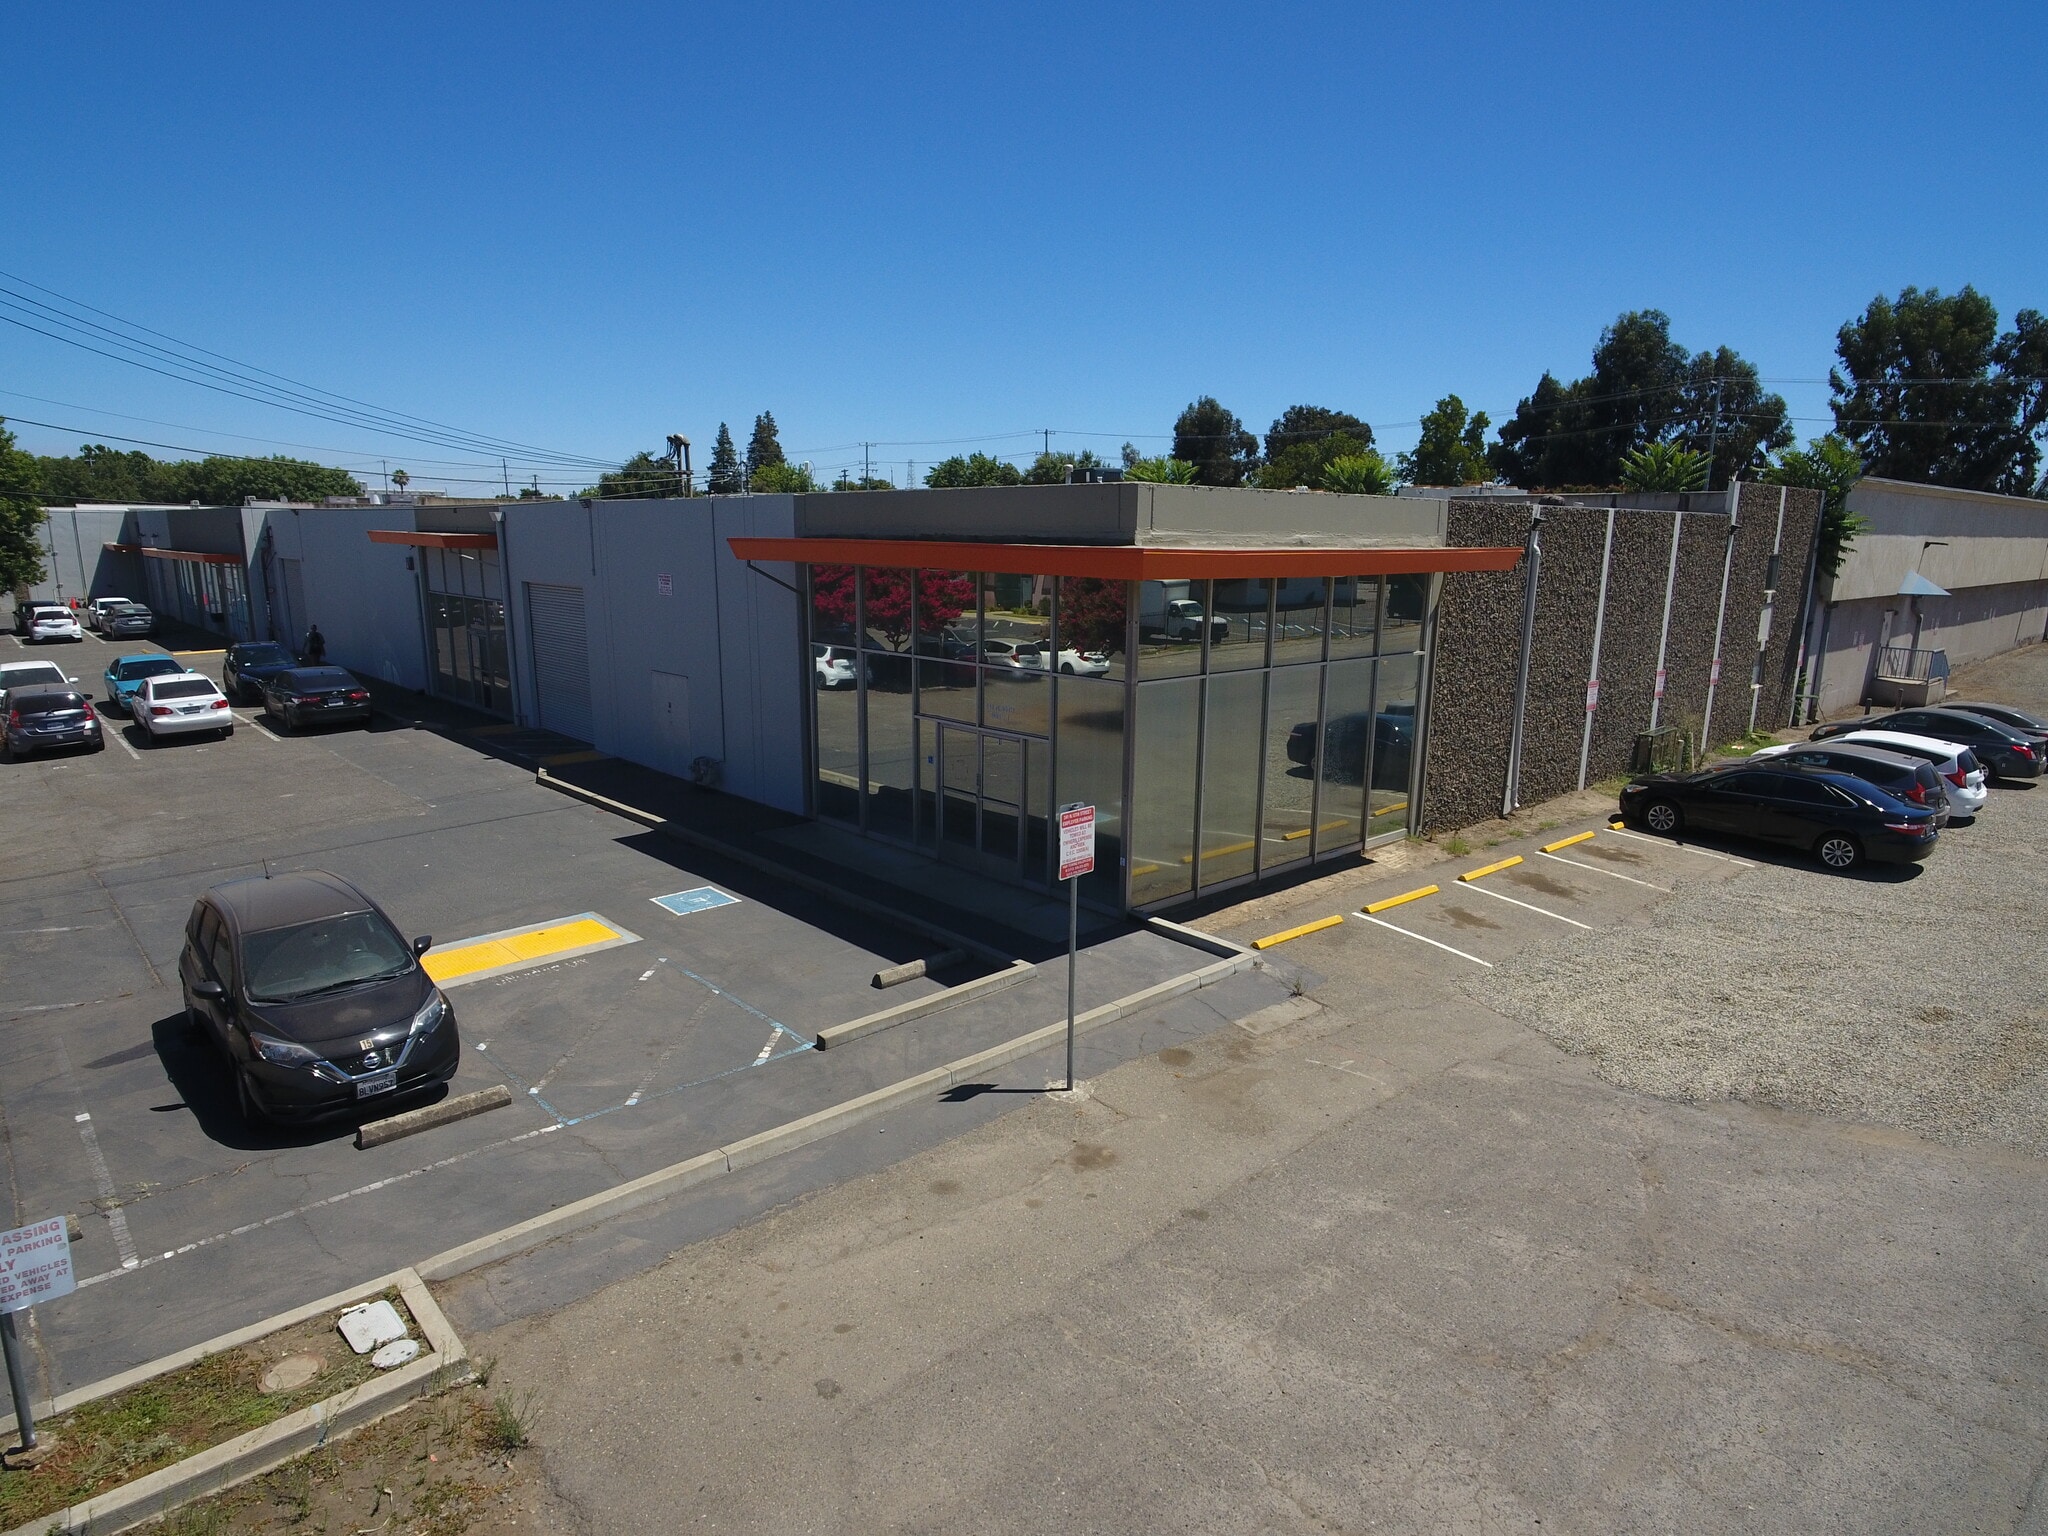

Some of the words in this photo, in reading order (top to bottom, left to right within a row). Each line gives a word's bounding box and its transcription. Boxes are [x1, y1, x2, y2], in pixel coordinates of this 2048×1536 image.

[1064, 826, 1079, 834] VEHICLES
[7, 1234, 62, 1256] PARKING
[14, 1258, 67, 1280] VEHICLES
[21, 1272, 50, 1288] AWAY
[56, 1267, 68, 1278] AT
[0, 1281, 51, 1303] EXPENSE
